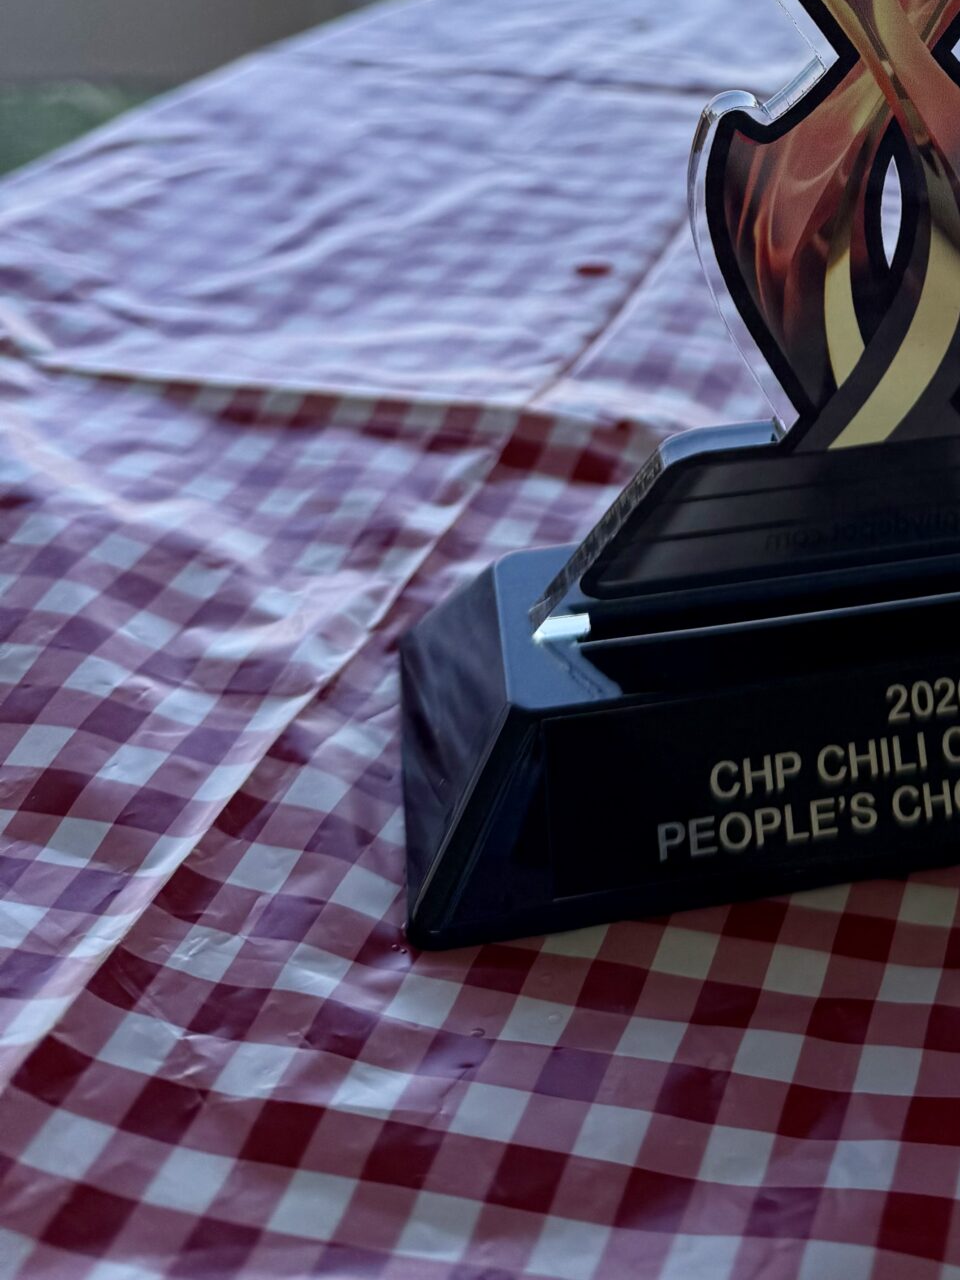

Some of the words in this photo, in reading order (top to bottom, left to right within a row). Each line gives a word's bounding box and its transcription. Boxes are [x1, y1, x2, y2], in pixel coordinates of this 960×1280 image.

[710, 751, 802, 799] CHP
[817, 732, 928, 782] CHILI
[657, 792, 878, 860] PEOPLE'S
